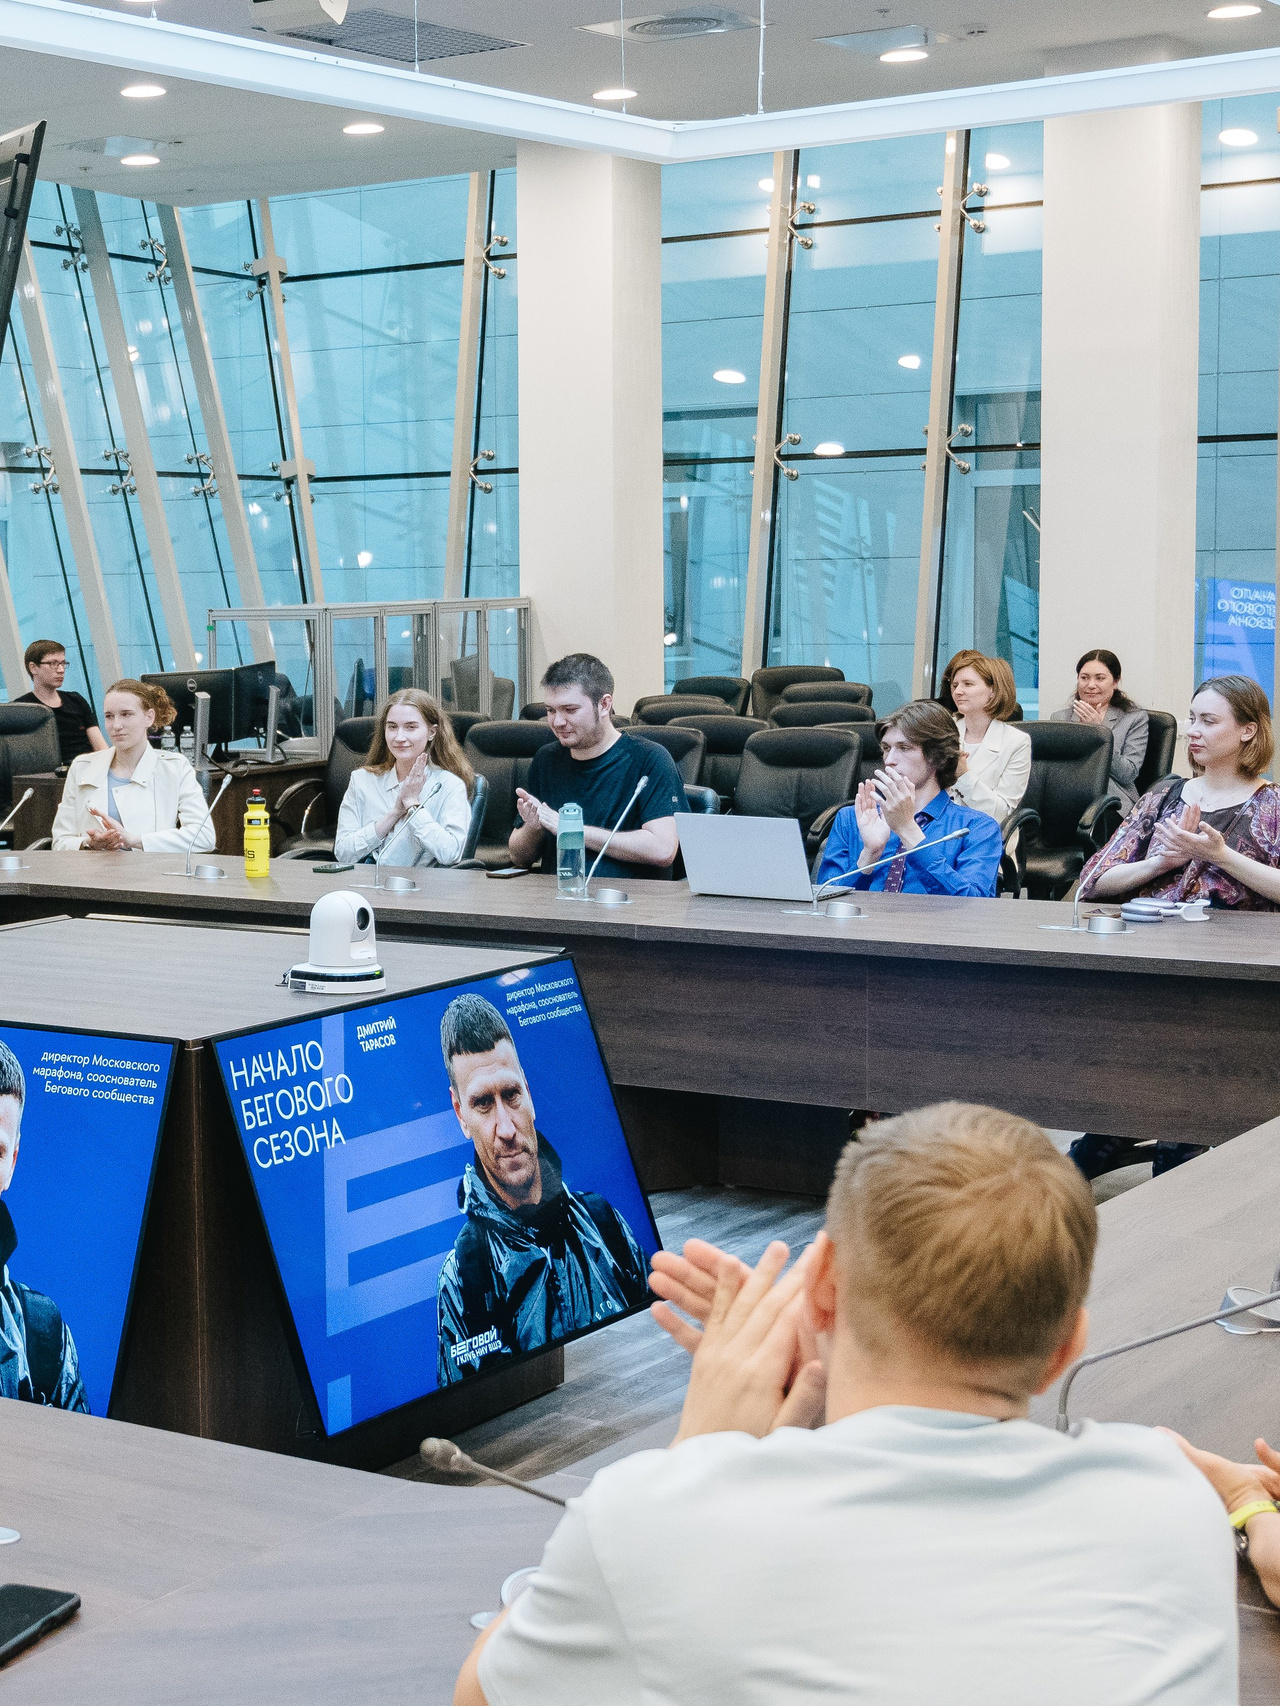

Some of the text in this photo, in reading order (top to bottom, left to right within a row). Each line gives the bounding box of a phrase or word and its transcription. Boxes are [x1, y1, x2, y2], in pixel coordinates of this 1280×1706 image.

[506, 977, 574, 1002] директор Московского
[506, 991, 578, 1016] марафона, сооснователь
[518, 1004, 582, 1027] Бегового сообщества
[356, 1016, 397, 1040] ДМИТРИЙ
[359, 1033, 397, 1053] ТАРАСОВ
[41, 1052, 160, 1073] директор Московского
[229, 1040, 324, 1091] НАЧАЛО
[33, 1066, 157, 1089] марафона, сооснователь
[45, 1081, 155, 1105] Бегового сообщества
[240, 1073, 354, 1130] БЕГОВОГО
[253, 1117, 347, 1169] СЕЗОНА
[450, 1325, 497, 1358] БЕГОВОЙ
[460, 1340, 502, 1364] КЛУБ НИУ ВШЭ
